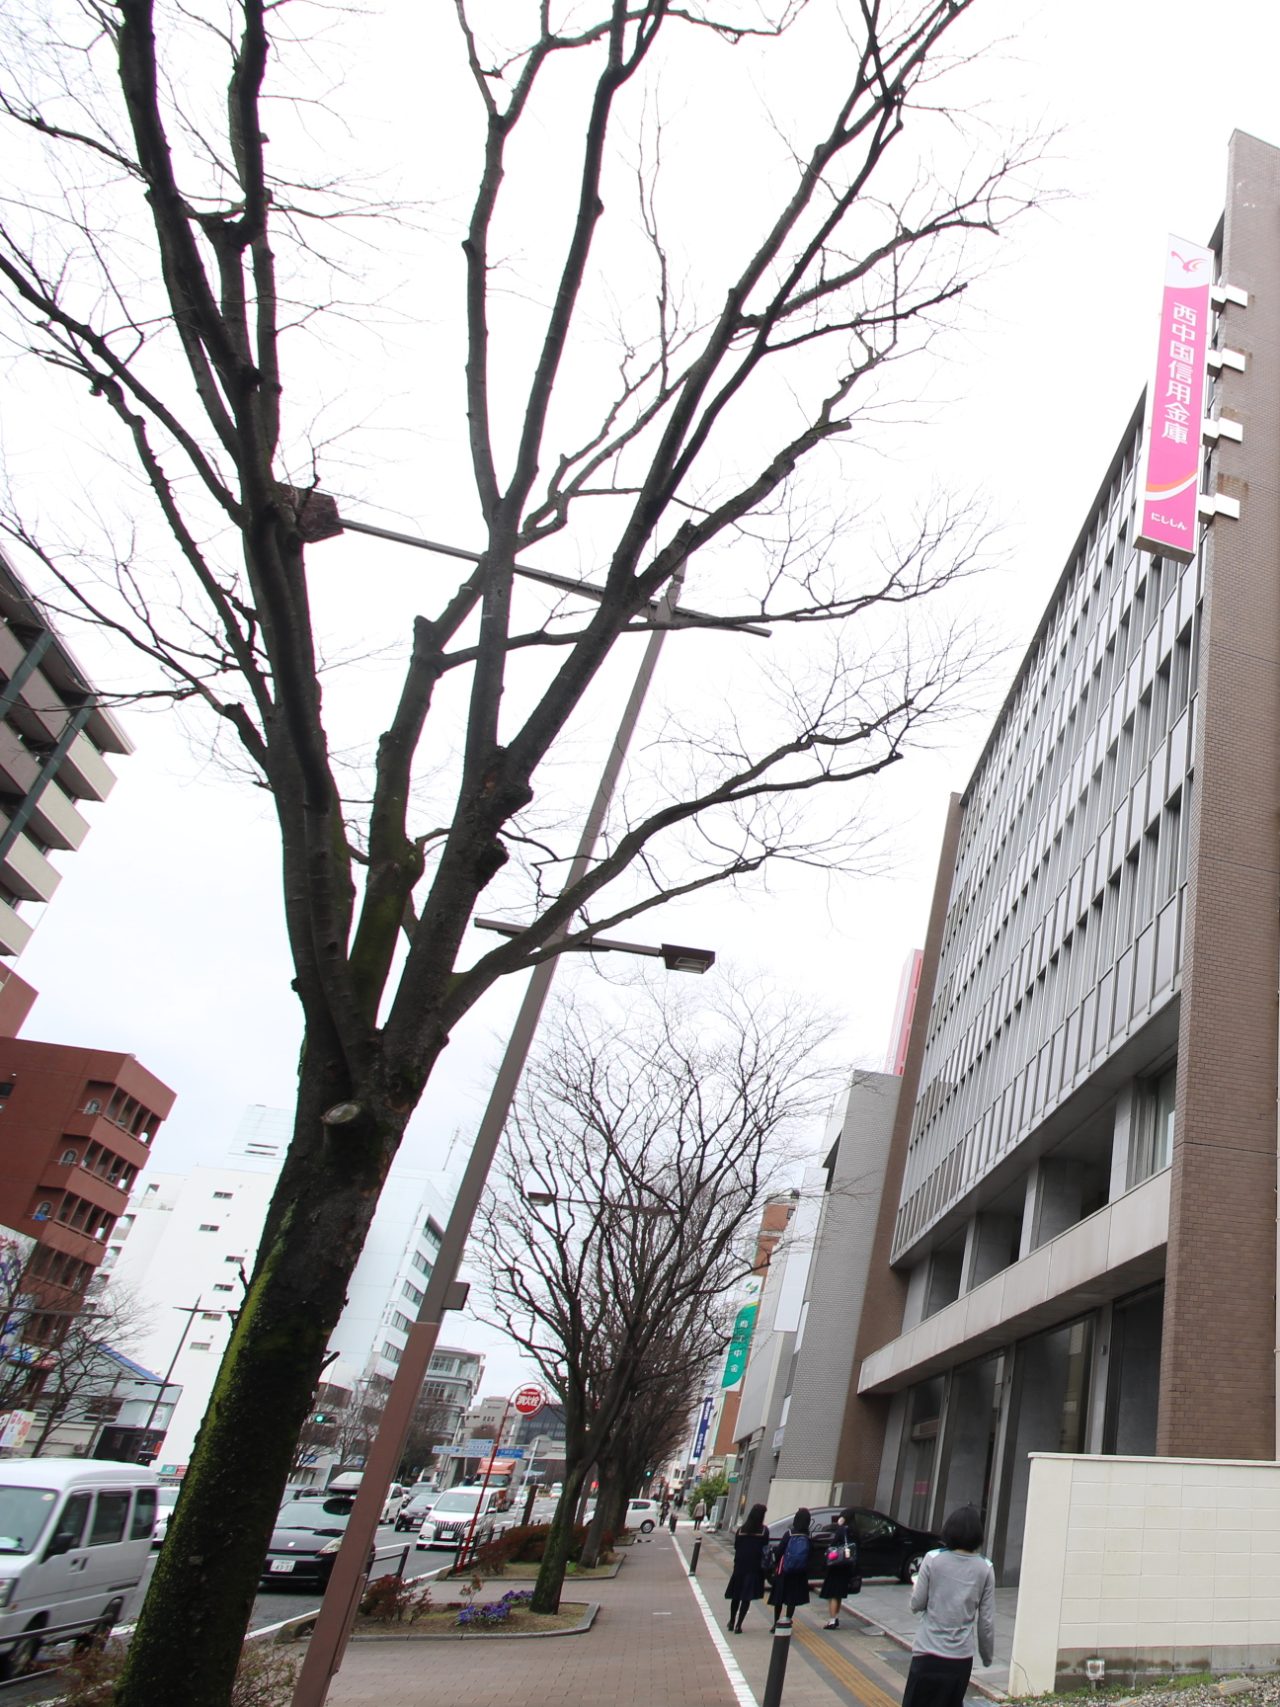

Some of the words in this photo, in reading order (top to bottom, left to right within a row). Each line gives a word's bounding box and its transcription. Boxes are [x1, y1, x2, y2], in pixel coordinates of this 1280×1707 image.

[1161, 301, 1198, 445] 西中国信用金庫
[1151, 511, 1188, 531] にししん
